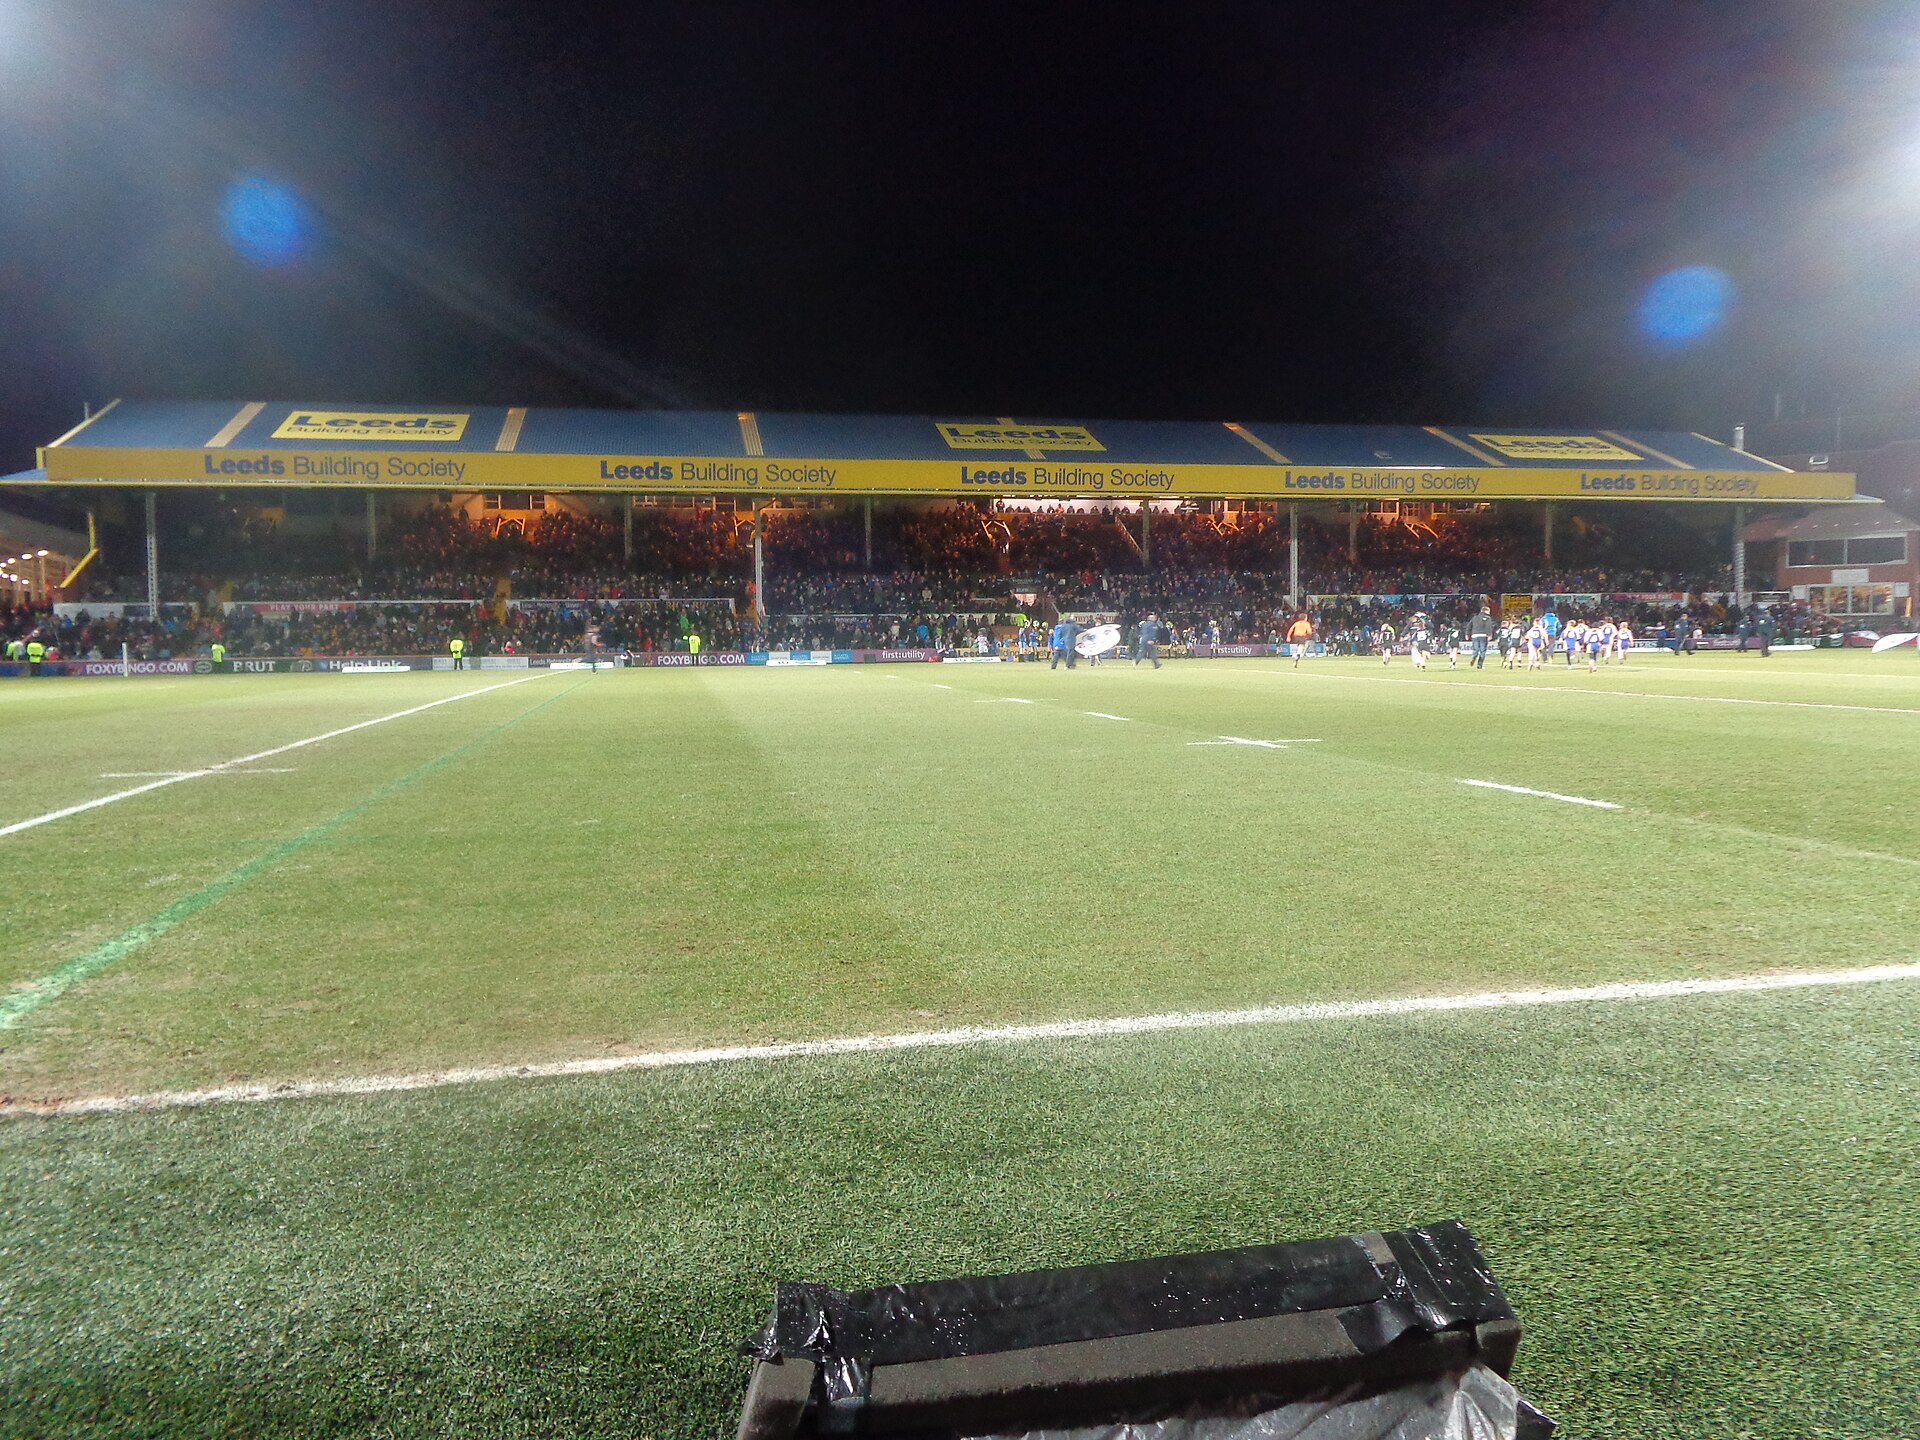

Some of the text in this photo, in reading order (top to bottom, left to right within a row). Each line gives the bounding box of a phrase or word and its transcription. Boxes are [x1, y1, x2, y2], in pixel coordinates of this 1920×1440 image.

[292, 415, 458, 428] Leeds
[286, 427, 371, 435] Building
[946, 427, 1087, 440] Leeds
[204, 454, 466, 480] Leeds Building Society
[600, 460, 837, 487] Leeds Building Society
[961, 466, 1176, 491] Leeds Building Society
[1285, 471, 1481, 494] Leeds Building Society
[1580, 473, 1760, 495] Leeds Building Society
[881, 650, 926, 660] first:utility
[86, 661, 189, 675] FOXYBNGO.COM
[232, 660, 276, 672] BRUT
